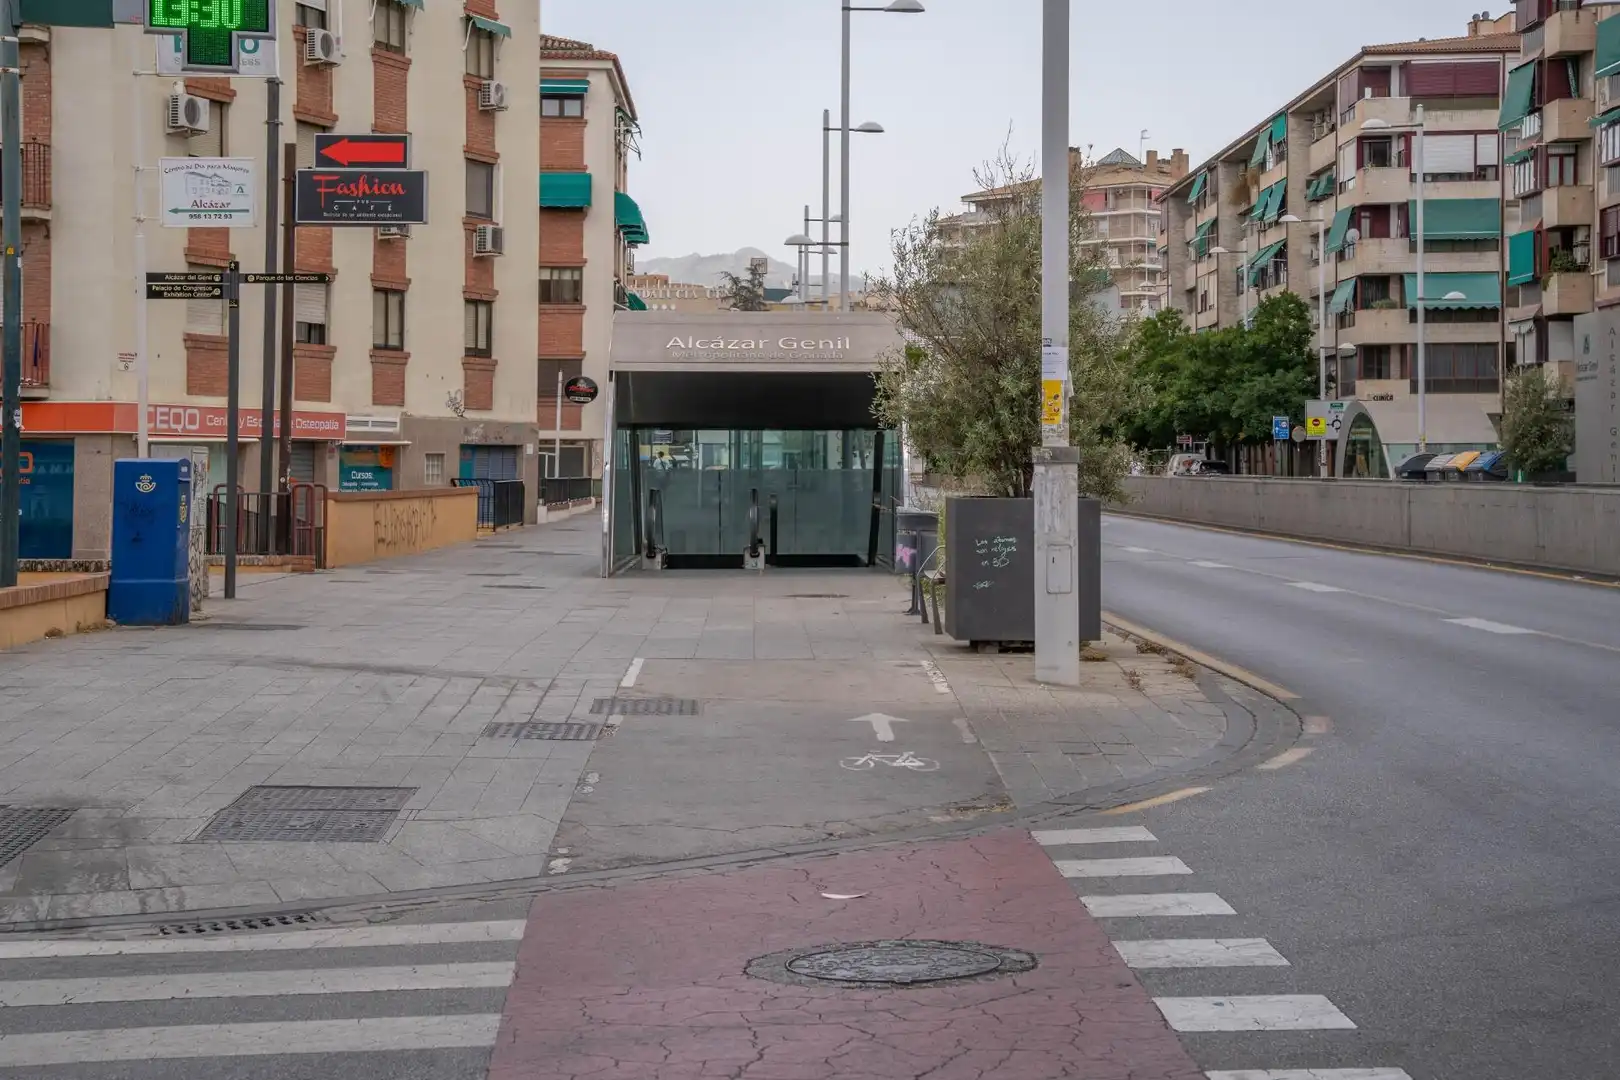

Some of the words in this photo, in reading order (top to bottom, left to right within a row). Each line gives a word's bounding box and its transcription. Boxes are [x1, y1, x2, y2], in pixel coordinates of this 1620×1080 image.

[152, 0, 240, 28] 13:30
[312, 174, 406, 208] Fashion
[190, 199, 231, 208] Alcázar
[666, 336, 770, 350] Alcázar
[778, 336, 850, 350] Genil
[672, 351, 766, 360] Metropolitano
[769, 351, 785, 360] de
[789, 351, 844, 360] Granada
[206, 414, 228, 426] Cen
[239, 416, 245, 428] y
[296, 418, 340, 432] Osteopatía
